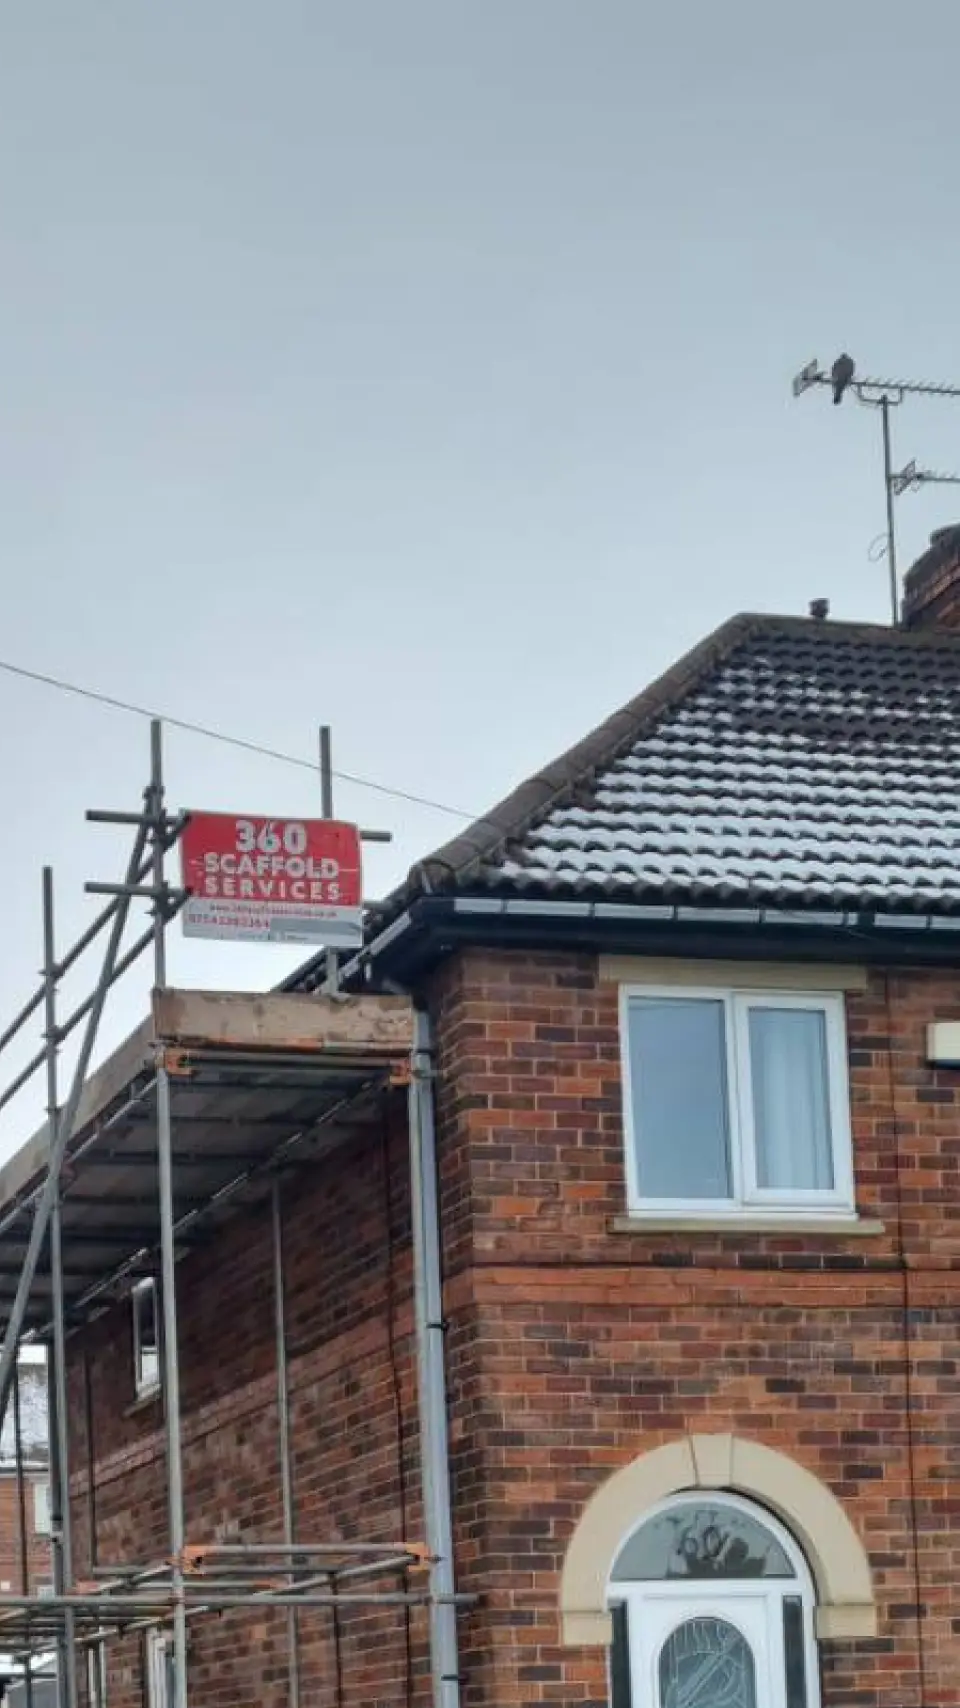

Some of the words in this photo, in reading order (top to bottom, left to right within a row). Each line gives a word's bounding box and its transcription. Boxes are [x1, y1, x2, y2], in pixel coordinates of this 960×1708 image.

[235, 819, 307, 854] 360
[203, 851, 339, 879] SCAFFOLD
[204, 875, 340, 900] SERVICES
